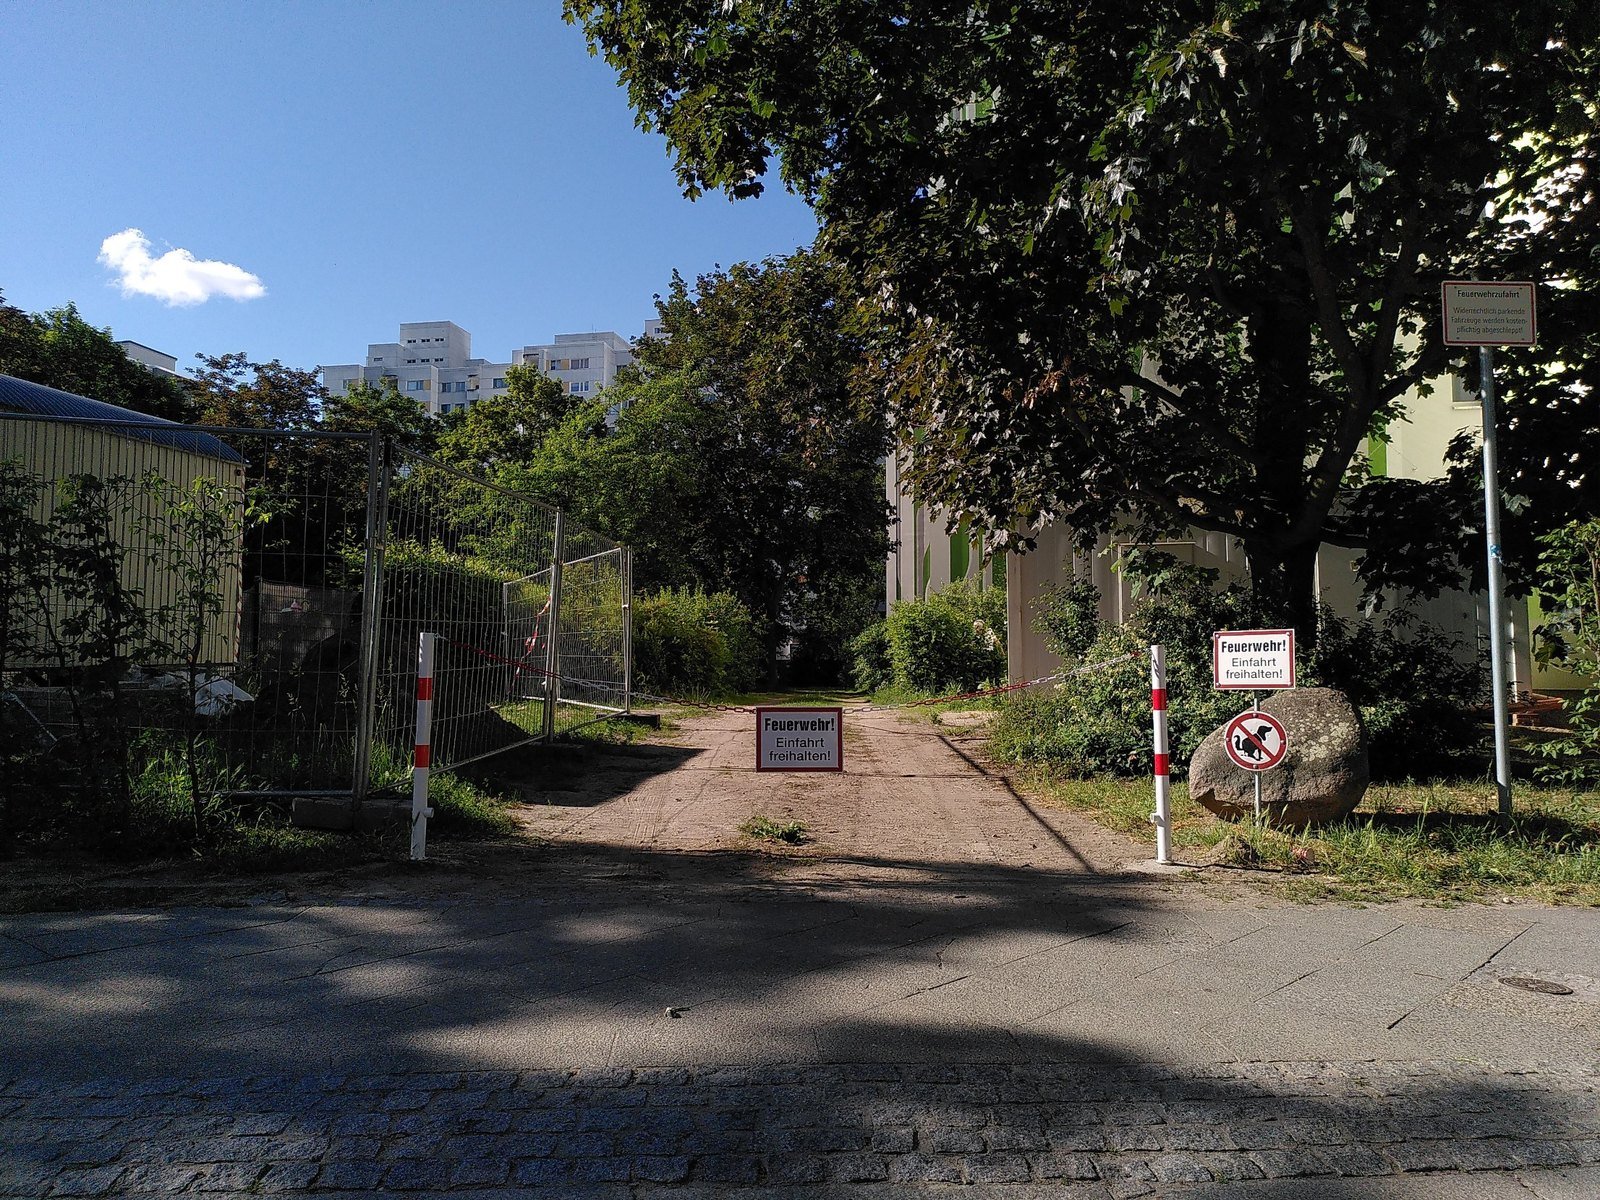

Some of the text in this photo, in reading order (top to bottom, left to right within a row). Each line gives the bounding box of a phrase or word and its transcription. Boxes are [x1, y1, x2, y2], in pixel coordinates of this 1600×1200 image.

[1457, 289, 1520, 298] Feuerwehrzufahrt
[1497, 308, 1525, 316] parkende
[1451, 316, 1481, 325] Fahrzeuge
[1456, 326, 1481, 334] pflichtig
[1221, 640, 1286, 653] Feuerwehr!
[1231, 657, 1277, 667] Einfahrt
[1226, 669, 1283, 679] freihalten!
[764, 718, 835, 732] Feuerwehr!
[776, 737, 825, 748] Einfahrt
[769, 750, 831, 761] freihalten!
